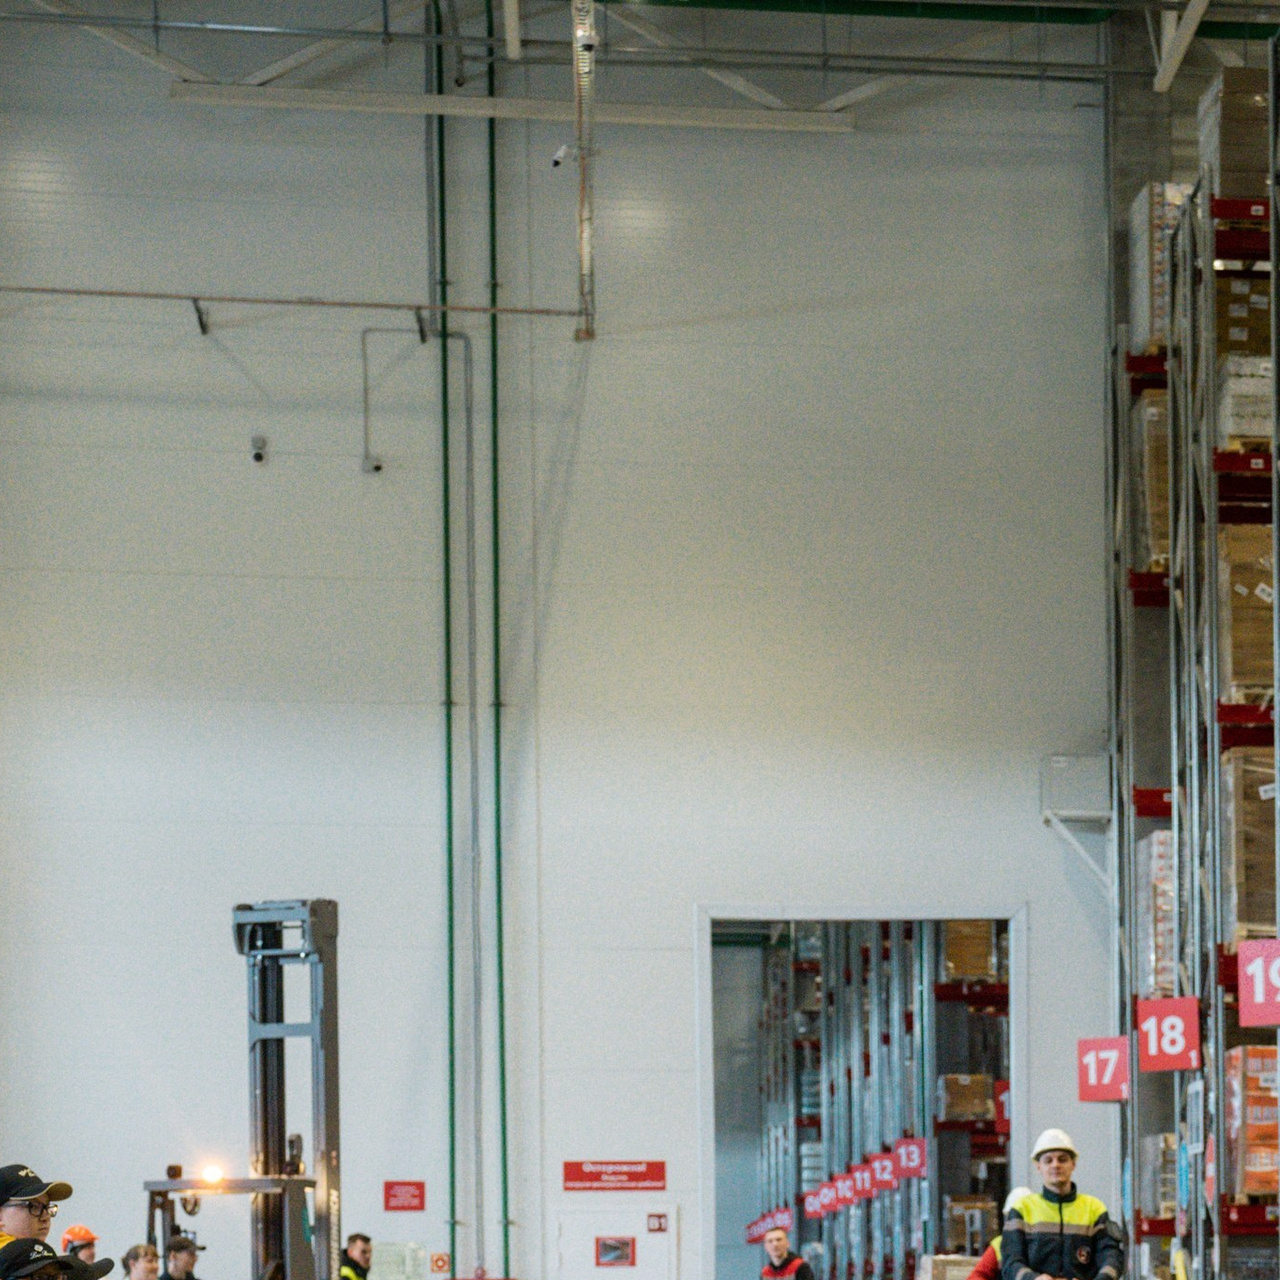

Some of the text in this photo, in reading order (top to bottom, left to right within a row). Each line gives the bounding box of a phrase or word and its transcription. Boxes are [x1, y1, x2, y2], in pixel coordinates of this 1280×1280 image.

[1141, 1015, 1186, 1056] 18
[1082, 1050, 1119, 1086] 17
[1189, 1049, 1198, 1067] 1
[1120, 1082, 1129, 1098] 1
[898, 1145, 920, 1168] 13
[872, 1159, 893, 1180] 12
[854, 1171, 871, 1190] 11
